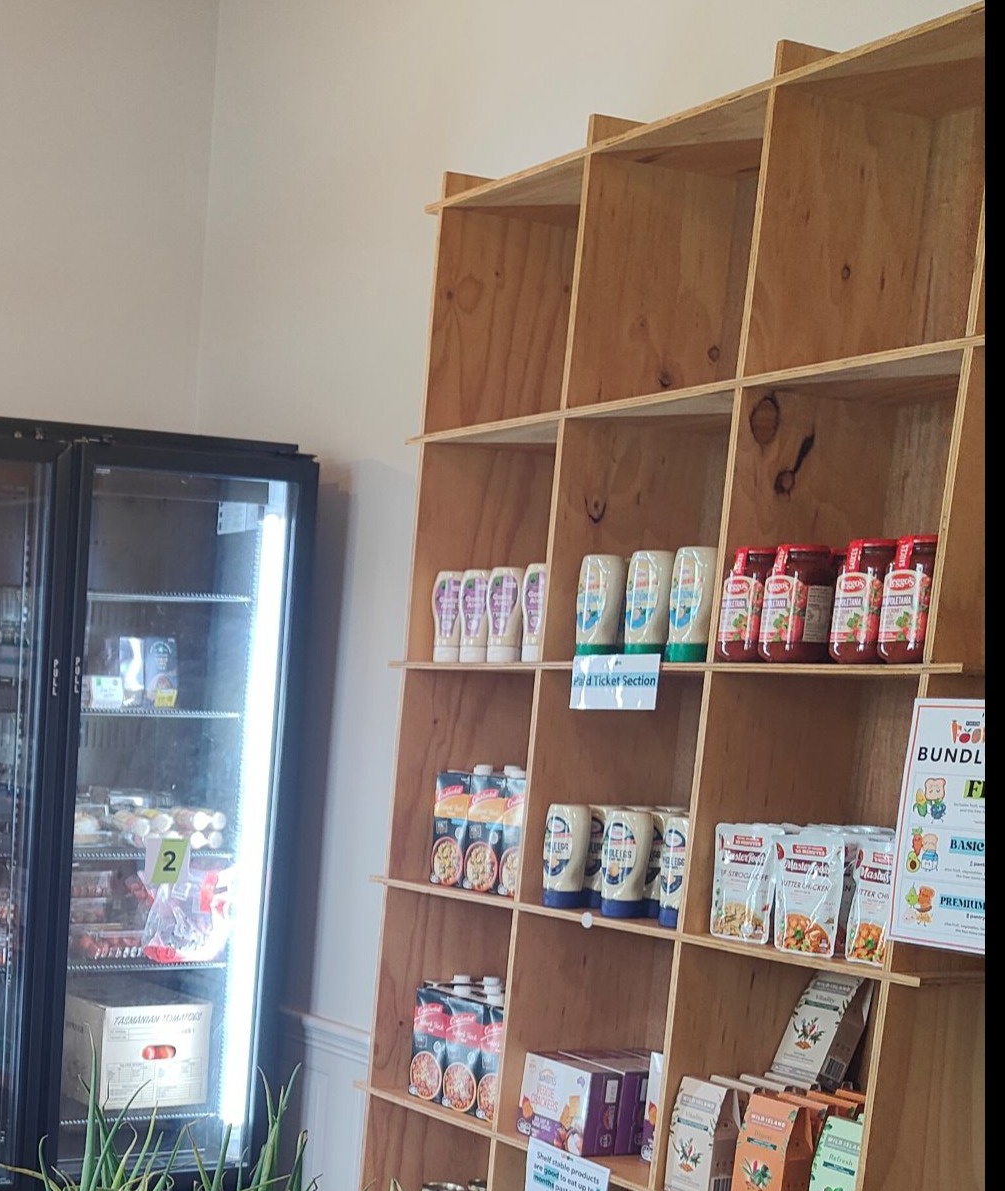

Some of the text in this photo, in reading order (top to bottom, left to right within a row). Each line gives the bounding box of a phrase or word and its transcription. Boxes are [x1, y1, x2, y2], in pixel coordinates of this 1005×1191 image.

[573, 675, 656, 687] Pad Ticket Section
[917, 746, 982, 764] BUNDL
[163, 851, 176, 872] 2
[114, 1014, 160, 1026] TASMANIAN
[751, 1113, 786, 1128] WILD ISLAND
[828, 1136, 842, 1145] WILD
[829, 1153, 853, 1167] Refresh
[537, 1151, 599, 1185] Shelf stable products
[533, 1175, 554, 1188] months
[534, 1163, 543, 1172] are
[544, 1166, 559, 1179] good
[567, 1179, 577, 1188] eat
[578, 1183, 586, 1191] up
